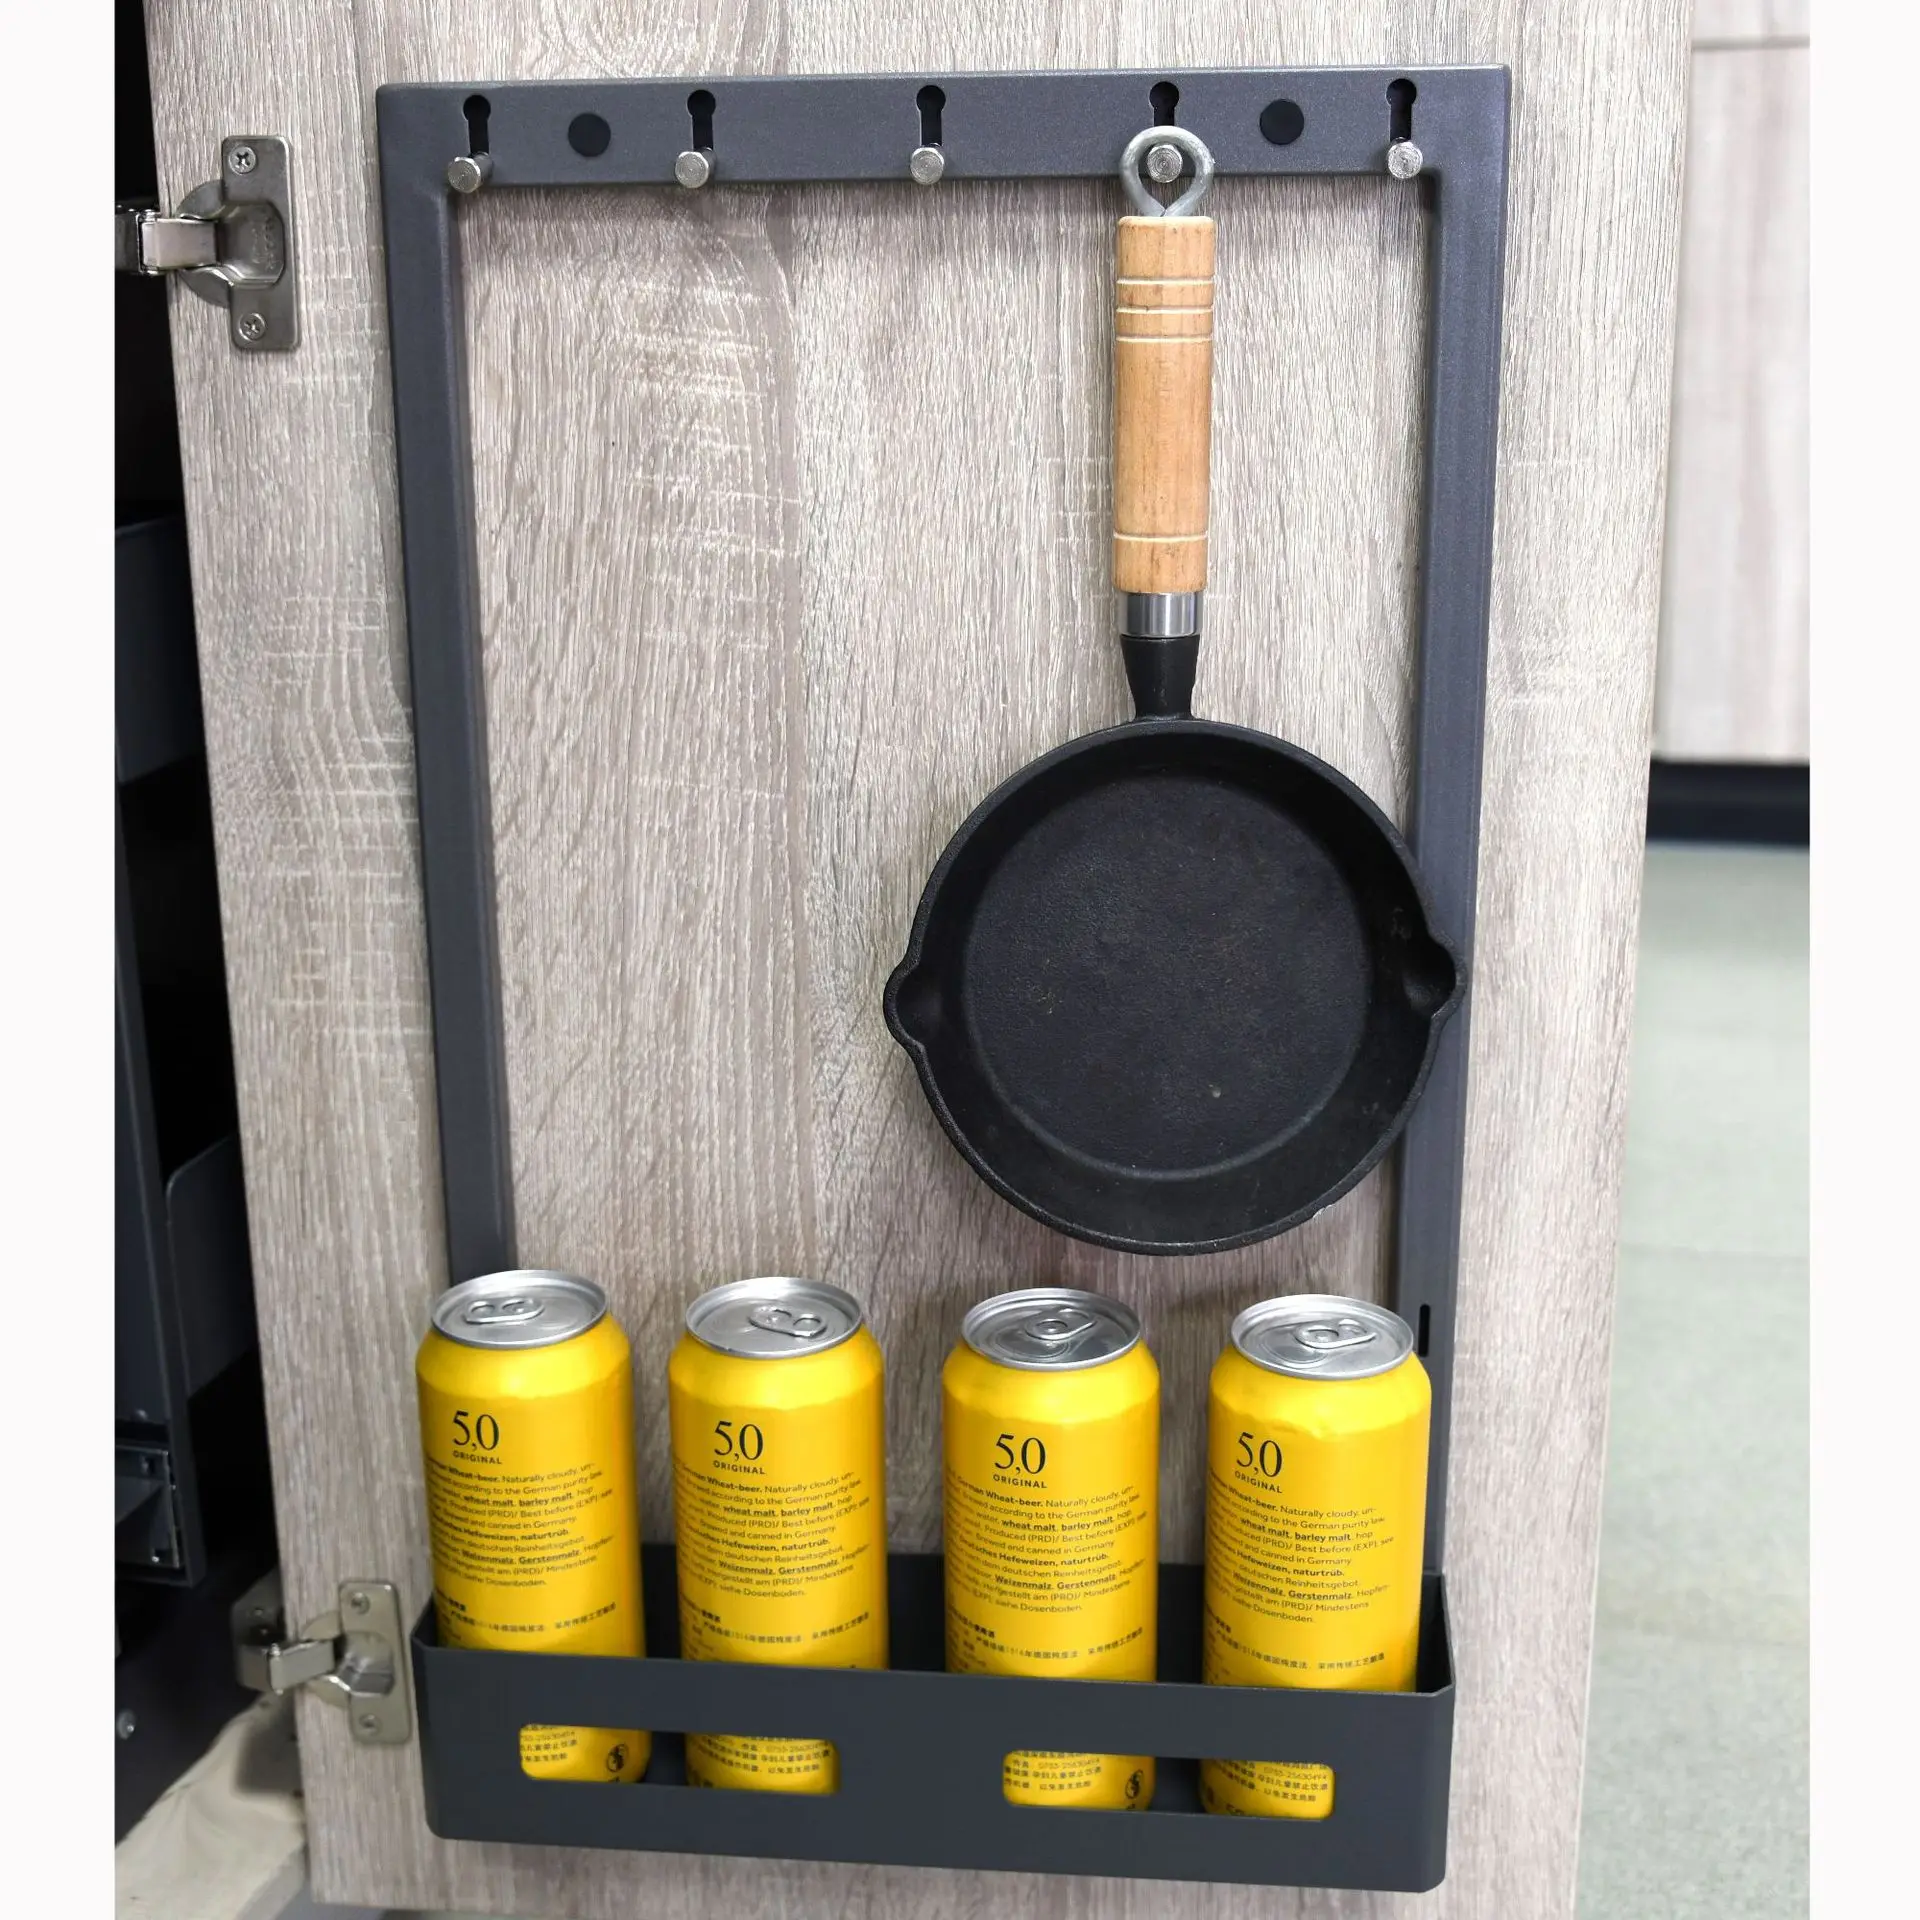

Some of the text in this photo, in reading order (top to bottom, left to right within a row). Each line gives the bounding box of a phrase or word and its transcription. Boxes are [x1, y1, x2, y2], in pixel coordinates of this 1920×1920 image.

[452, 1410, 500, 1451] 5,0
[714, 1420, 764, 1461] 5,0
[452, 1451, 502, 1464] ORIGINAL
[994, 1433, 1046, 1475] 5,0
[1236, 1431, 1282, 1478] 5,0
[713, 1460, 766, 1475] ORIGINAL
[993, 1473, 1047, 1489] ORIGINAL
[1234, 1470, 1282, 1494] ORIGINAL
[764, 1484, 807, 1494] Naturally
[519, 1497, 549, 1508] barley
[755, 1497, 766, 1505] to
[767, 1497, 783, 1505] the
[785, 1495, 823, 1505] German
[985, 1489, 1043, 1508] Wheat-beer.
[1045, 1498, 1089, 1508] Naturally
[723, 1505, 752, 1517] wheat
[780, 1507, 811, 1518] barley
[989, 1504, 1033, 1520] according
[1035, 1511, 1046, 1519] to
[1047, 1510, 1064, 1520] the
[1066, 1508, 1104, 1519] German
[1280, 1504, 1324, 1520] Naturally
[1001, 1519, 1032, 1530] wheat
[1061, 1521, 1092, 1532] barley
[1240, 1517, 1266, 1533] wheat
[1294, 1531, 1326, 1543] barley
[1270, 1514, 1280, 1524] to
[1282, 1517, 1298, 1527] the
[1300, 1519, 1340, 1530] German
[1342, 1519, 1369, 1531] purity
[1026, 1546, 1062, 1555] canned
[1260, 1549, 1295, 1564] canned
[1296, 1555, 1305, 1564] in
[1295, 1543, 1317, 1553] Best
[1319, 1543, 1352, 1555] before
[999, 1552, 1059, 1567] Hefeweizen,
